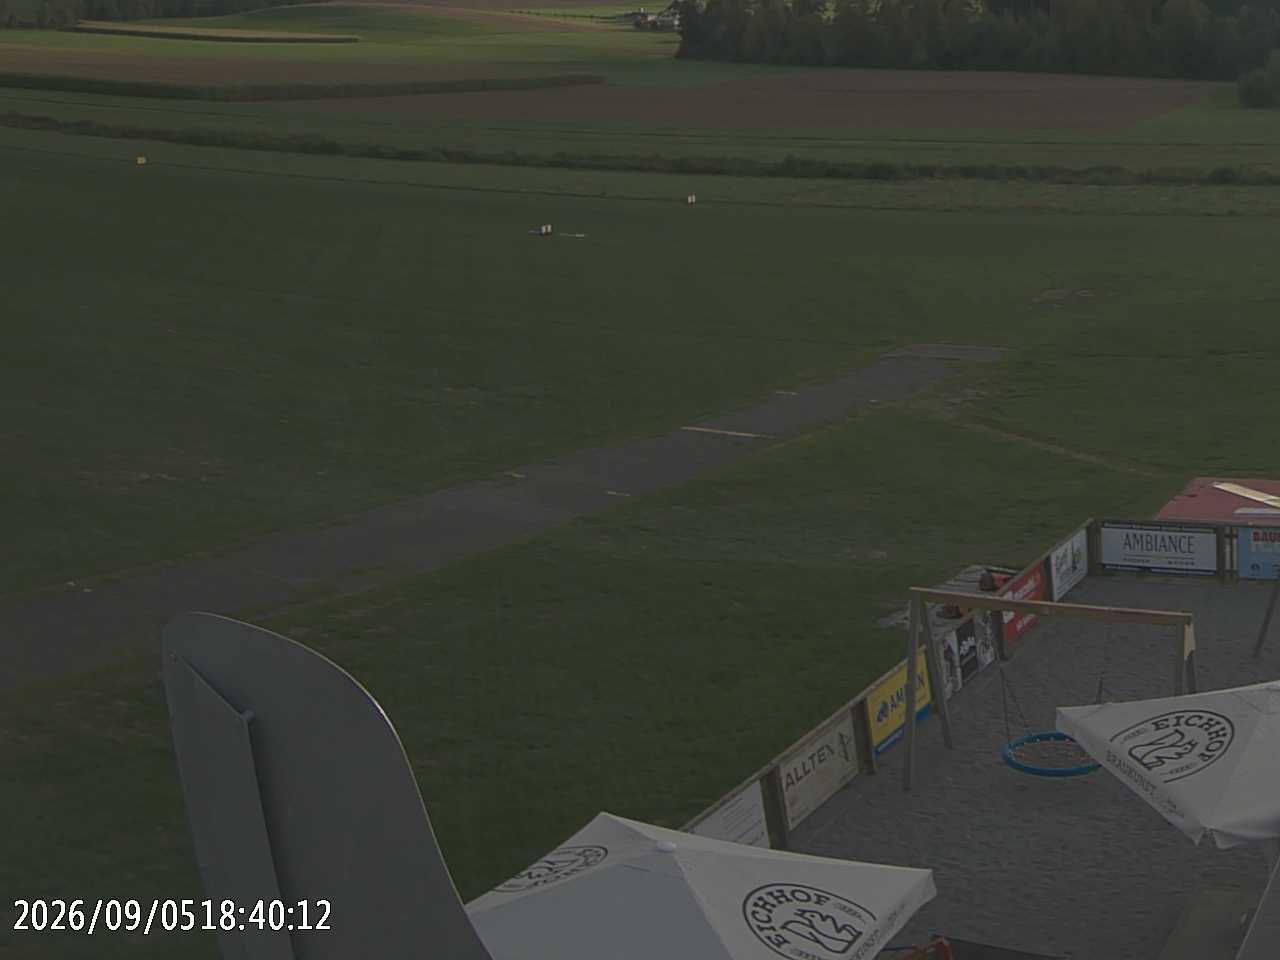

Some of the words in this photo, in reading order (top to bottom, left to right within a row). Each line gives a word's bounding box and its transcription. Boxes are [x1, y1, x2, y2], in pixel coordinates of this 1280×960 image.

[1122, 532, 1195, 554] AMBIANCE
[1151, 714, 1227, 763] EICHHOF
[751, 888, 830, 949] EICHHOF
